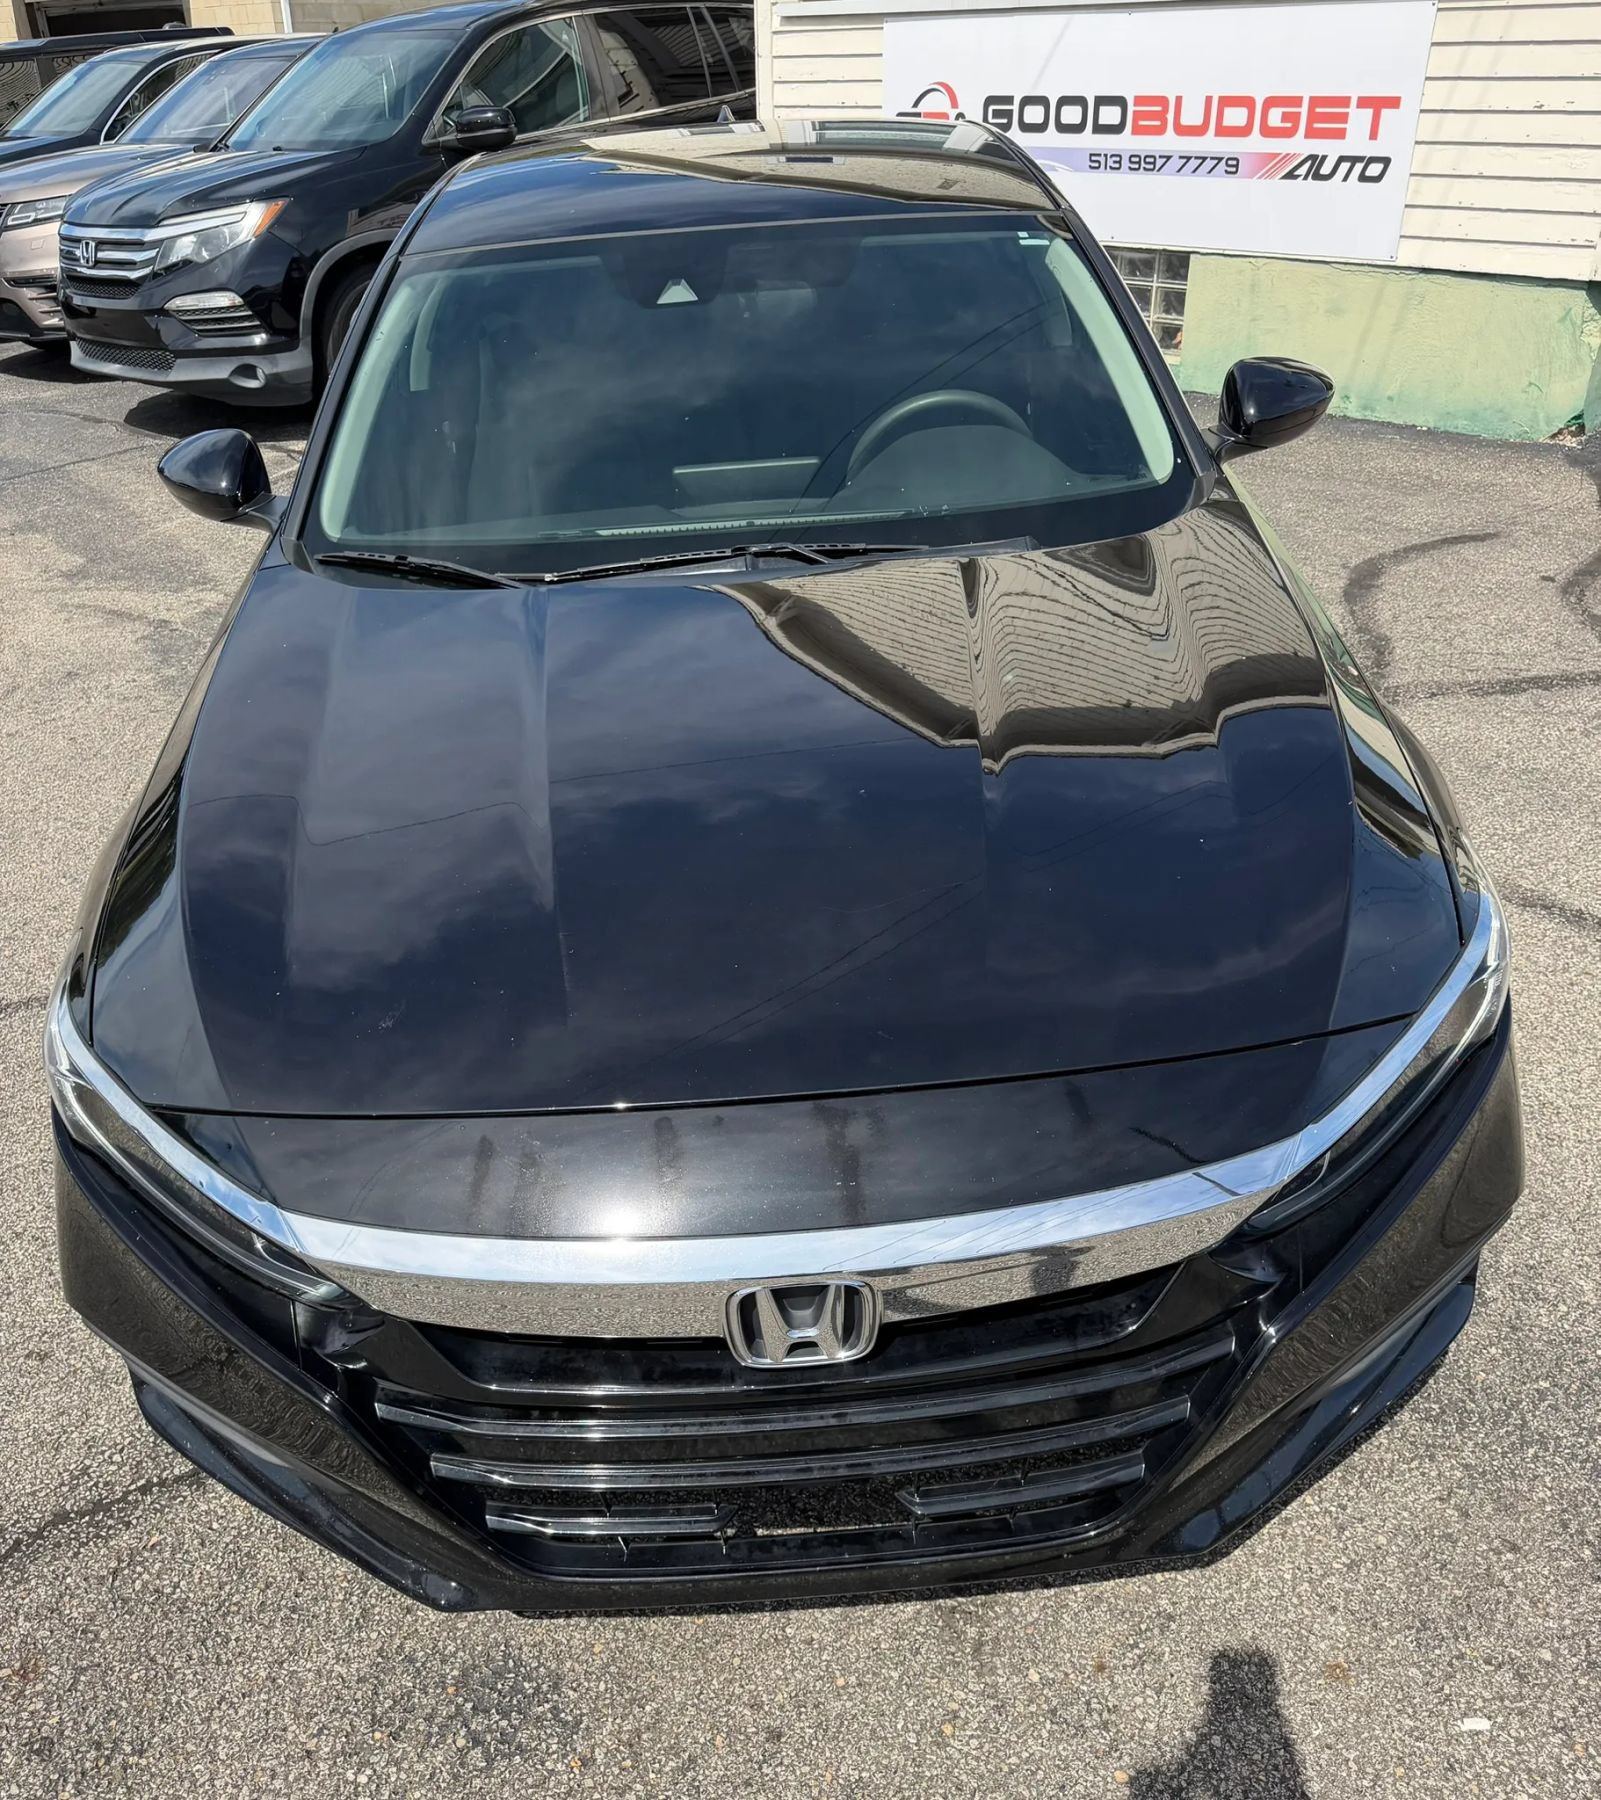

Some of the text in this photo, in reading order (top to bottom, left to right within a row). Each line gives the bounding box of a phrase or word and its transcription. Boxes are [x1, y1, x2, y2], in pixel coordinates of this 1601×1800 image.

[1088, 152, 1240, 175] 513 997 7779
[1279, 153, 1392, 183] AUTO
